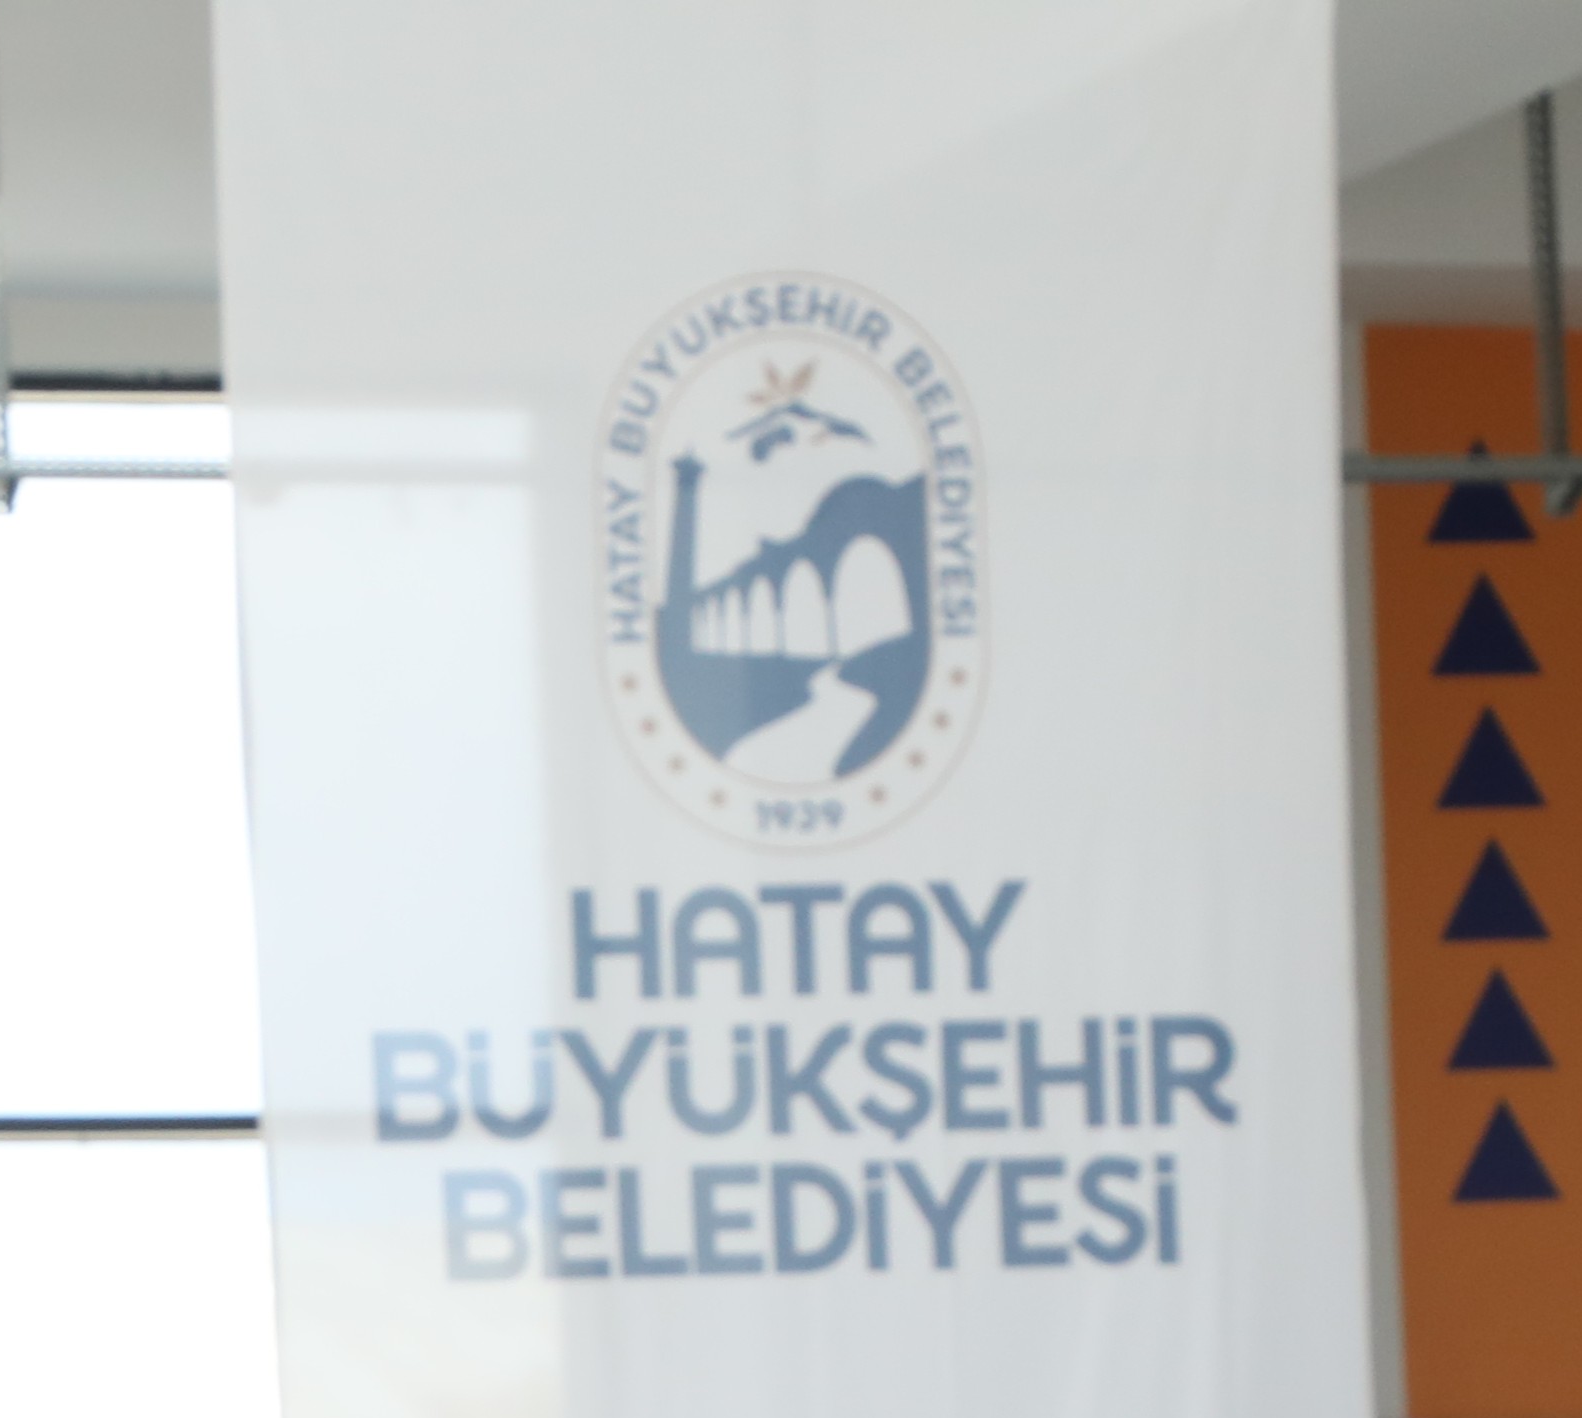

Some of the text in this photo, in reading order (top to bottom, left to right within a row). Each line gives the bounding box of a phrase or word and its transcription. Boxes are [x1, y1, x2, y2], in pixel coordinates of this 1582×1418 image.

[607, 478, 646, 643] HATAY
[569, 879, 1027, 1000] HATAY
[371, 1015, 1239, 1142] BÜYÜKŞEHİR
[441, 1155, 1180, 1281] BELEDİYESİ
